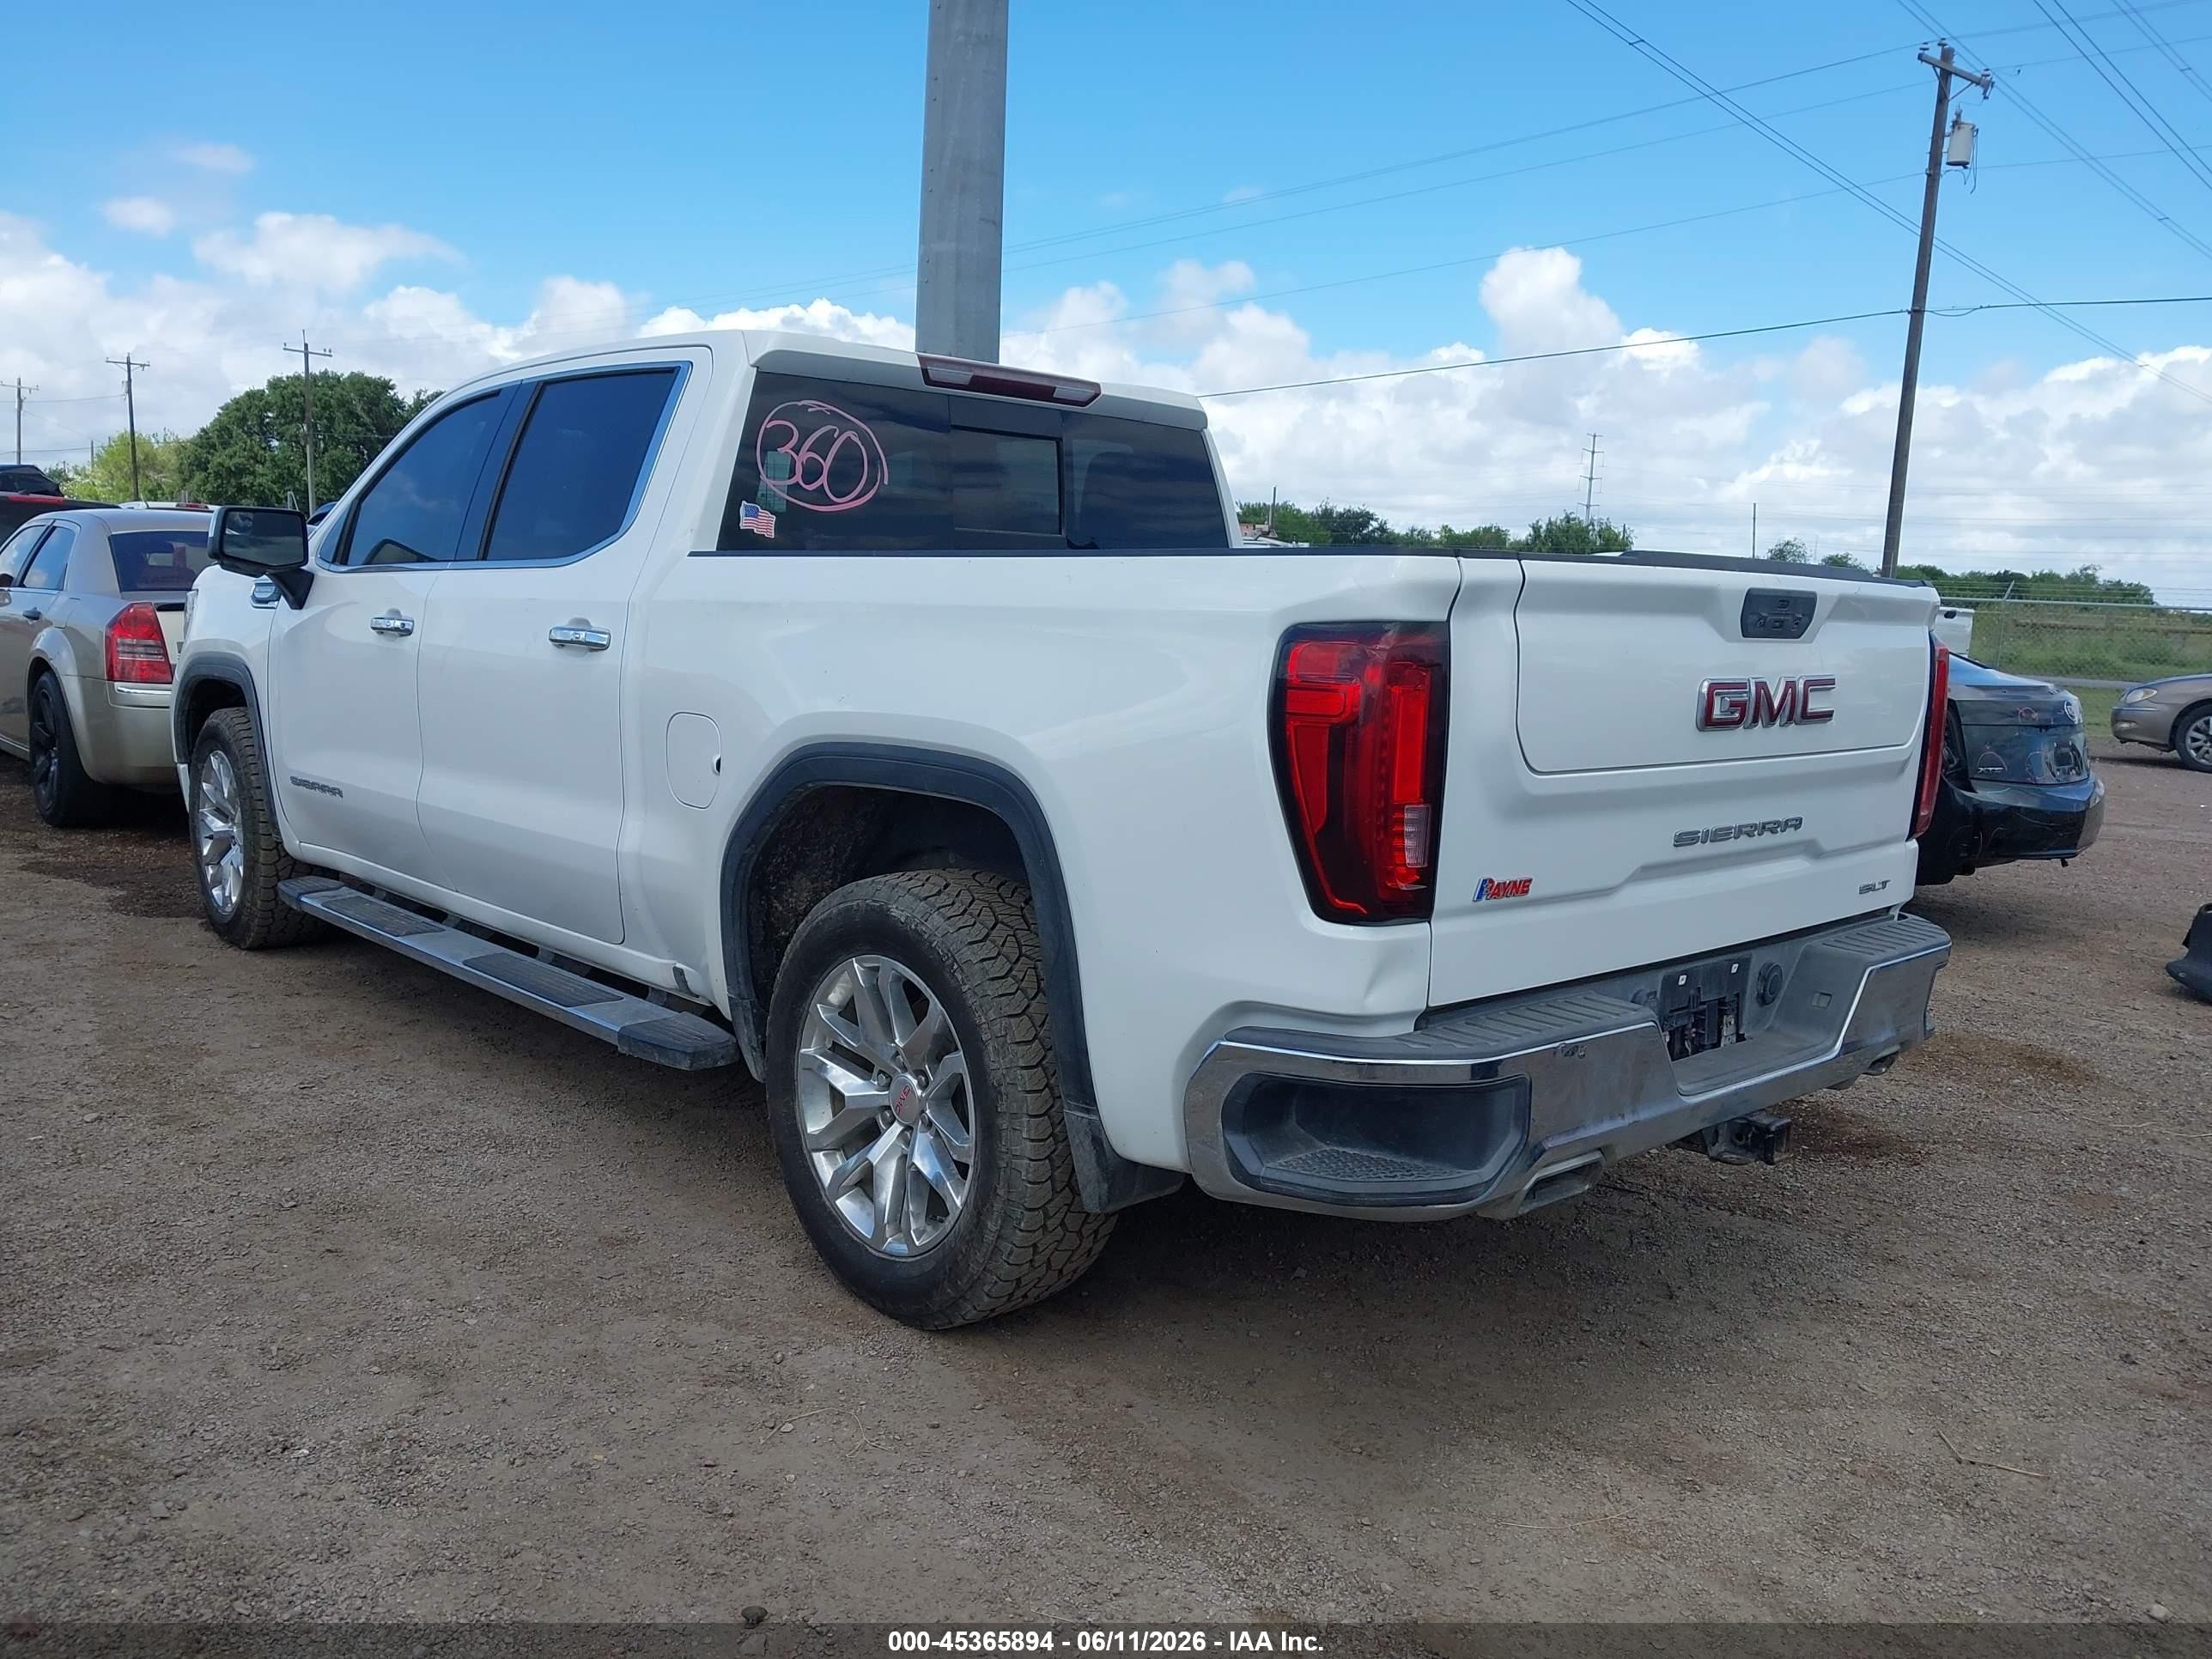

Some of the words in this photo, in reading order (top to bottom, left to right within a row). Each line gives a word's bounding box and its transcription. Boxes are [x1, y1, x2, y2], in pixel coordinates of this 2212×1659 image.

[766, 420, 868, 503] 360
[1696, 674, 1836, 732] GMC
[1673, 816, 1803, 848] SIERRA
[1472, 877, 1534, 902] PAYNE
[1858, 879, 1891, 895] SLT
[895, 1084, 911, 1115] GMC
